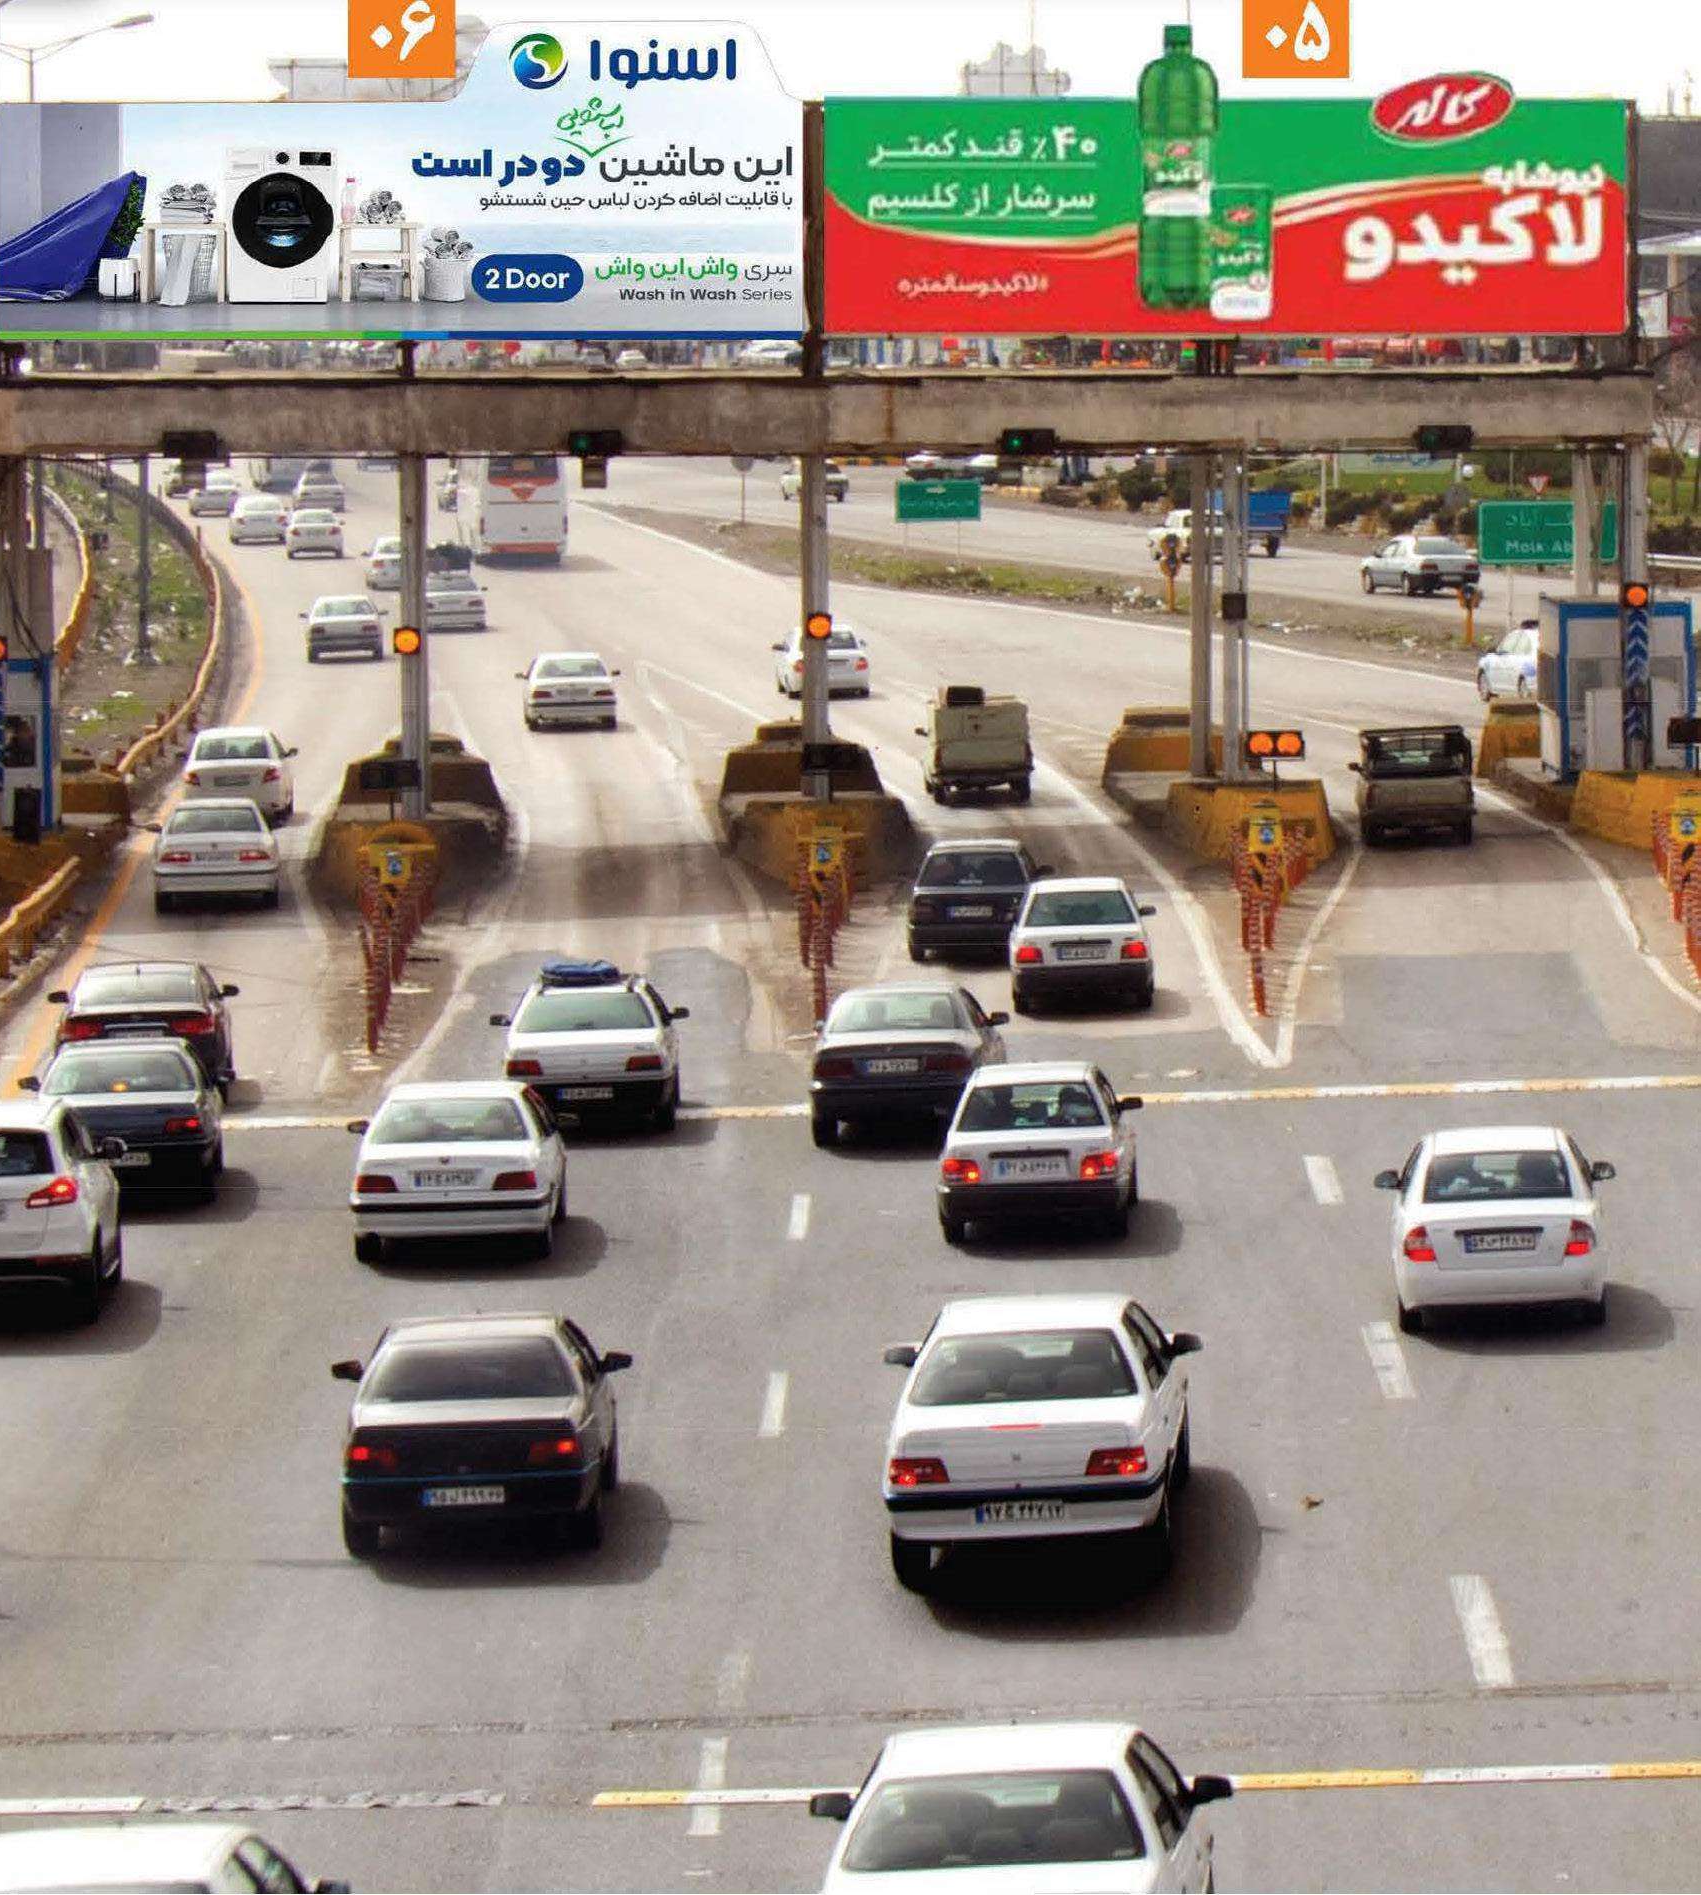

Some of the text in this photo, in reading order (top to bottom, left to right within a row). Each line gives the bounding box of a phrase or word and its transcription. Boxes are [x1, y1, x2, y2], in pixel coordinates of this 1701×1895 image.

[590, 38, 737, 90] اسنوا
[867, 129, 957, 167] کمتر
[962, 127, 1024, 158] قند
[411, 149, 493, 178] است
[599, 144, 724, 186] ماشین
[733, 146, 793, 186] این
[1480, 159, 1606, 196] نوشابه
[479, 191, 793, 211] با قابلیت اضافه کردن لباس حین شستشو
[867, 182, 1096, 218] سرشار از کلسیم
[1343, 193, 1603, 286] لاکیدو
[485, 268, 570, 290] 2 Door
[594, 256, 646, 282] واش
[649, 256, 685, 281] این
[687, 256, 739, 281] واش
[619, 288, 793, 301] Wash in Wash Series
